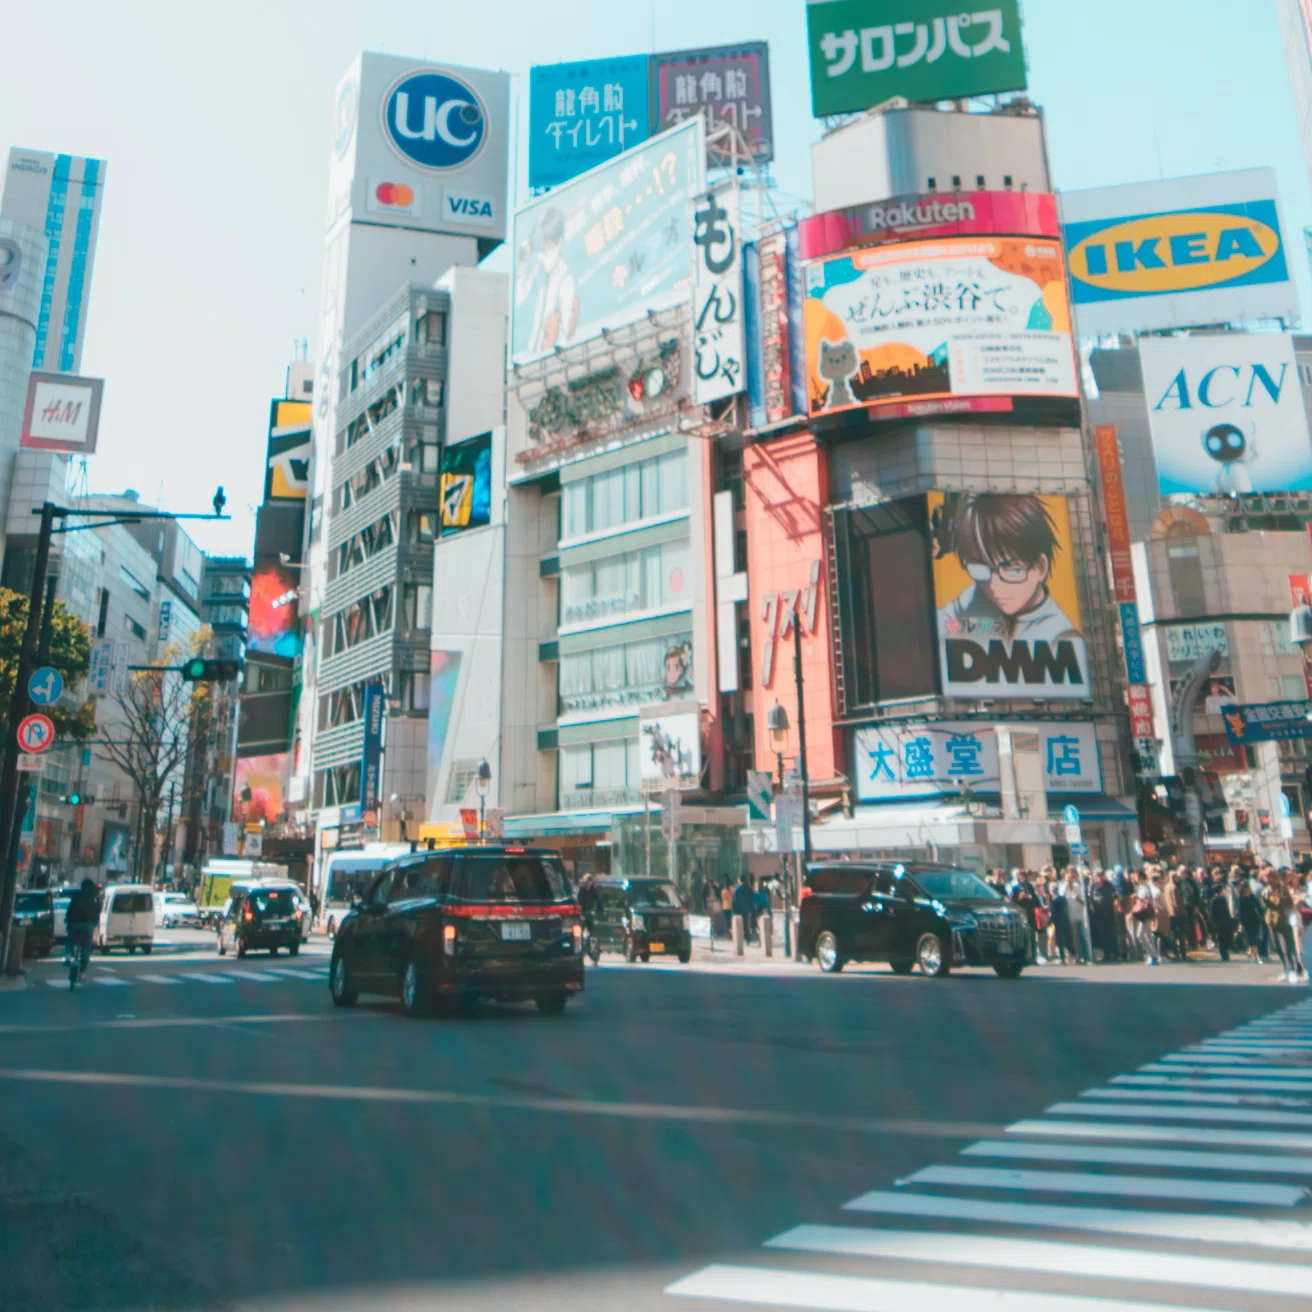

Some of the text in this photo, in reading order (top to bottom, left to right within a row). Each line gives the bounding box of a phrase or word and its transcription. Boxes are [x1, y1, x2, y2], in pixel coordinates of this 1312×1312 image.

[820, 9, 1011, 77] サロンパス
[555, 83, 623, 117] 龍角散
[675, 68, 746, 104] 龍角散
[545, 114, 637, 149] ダイレクト
[666, 102, 762, 134] ダレクト
[449, 197, 492, 217] VISA
[870, 200, 975, 231] Rakuten
[1085, 228, 1265, 276] IKEA
[693, 194, 741, 388] もんじゃ
[1154, 363, 1290, 411] ACN
[42, 398, 82, 425] H&M
[945, 639, 1083, 685] DMM
[869, 735, 1081, 780] 大盛堂店
